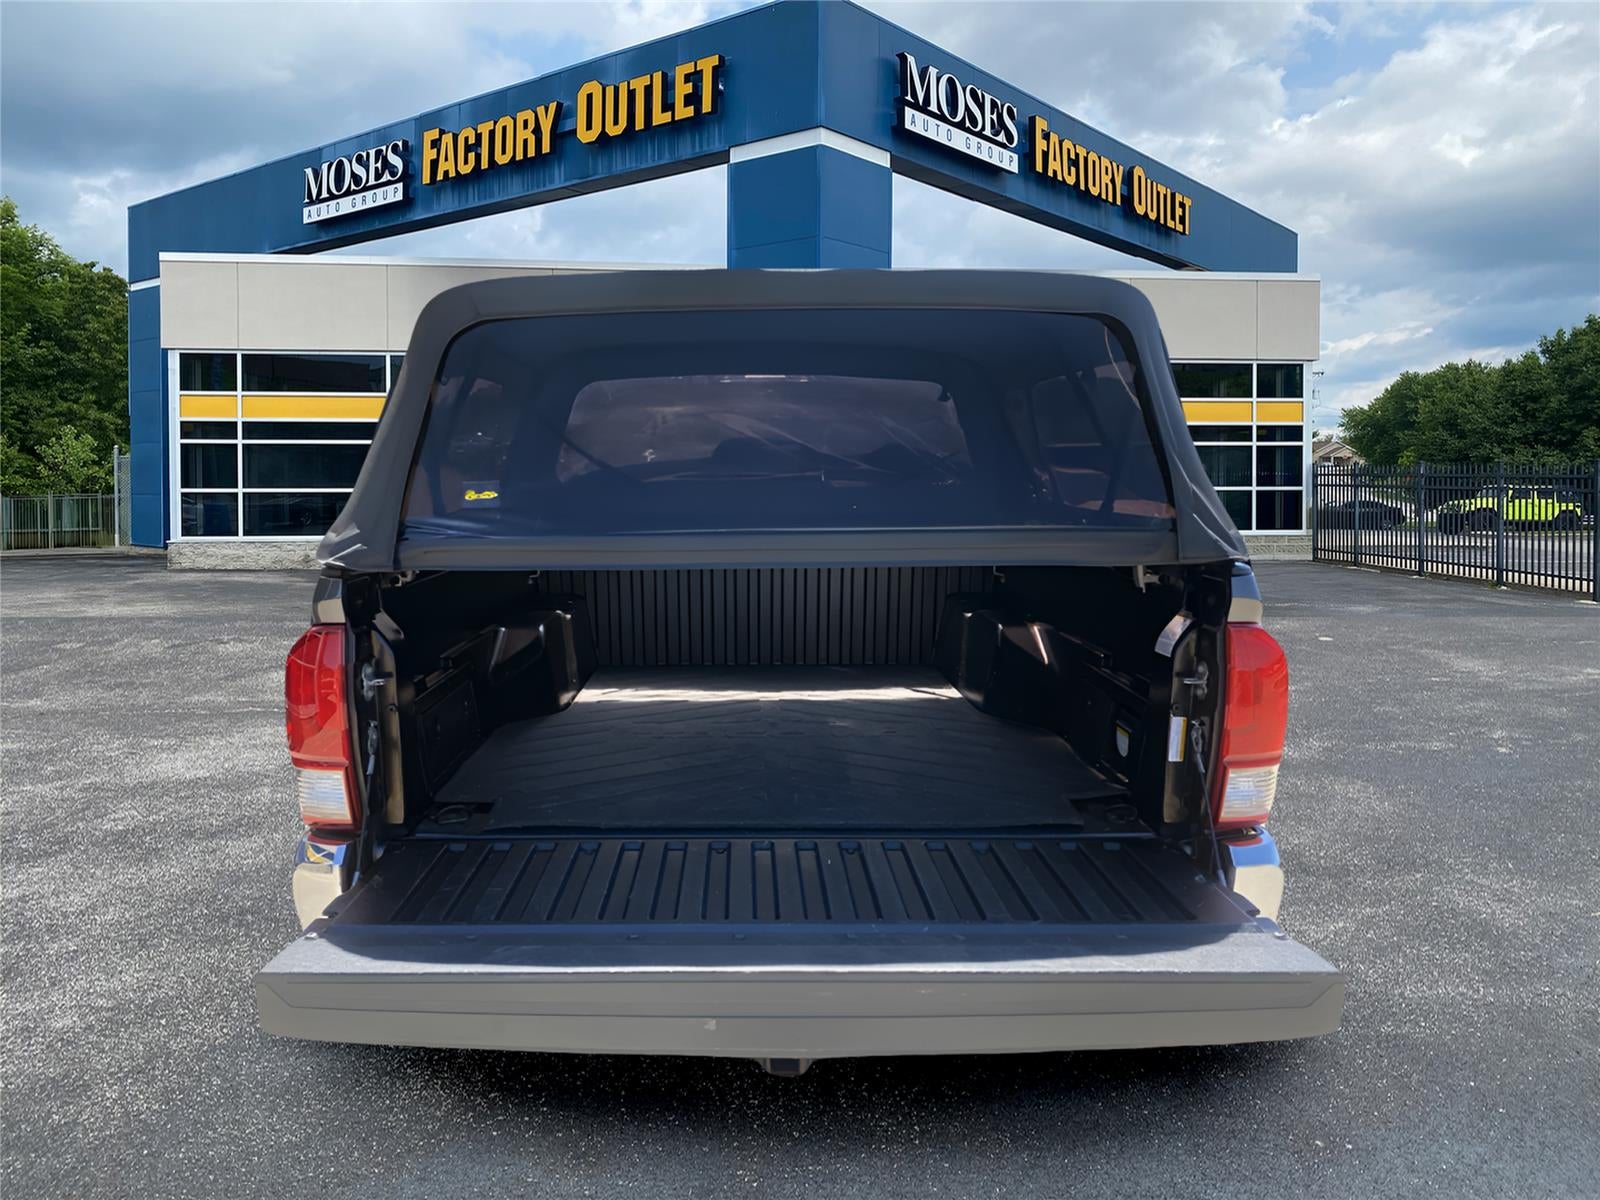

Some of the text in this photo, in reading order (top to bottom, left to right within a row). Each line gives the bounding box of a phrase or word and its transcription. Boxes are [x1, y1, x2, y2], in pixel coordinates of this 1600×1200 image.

[422, 54, 720, 185] FACTORY OUTLET
[903, 52, 1018, 148] MOSES
[910, 112, 1015, 167] AUTO GROUP
[303, 139, 404, 203] MOSES
[307, 186, 400, 220] AUTO GROUP
[1035, 115, 1192, 235] FACTORY OUTLET
